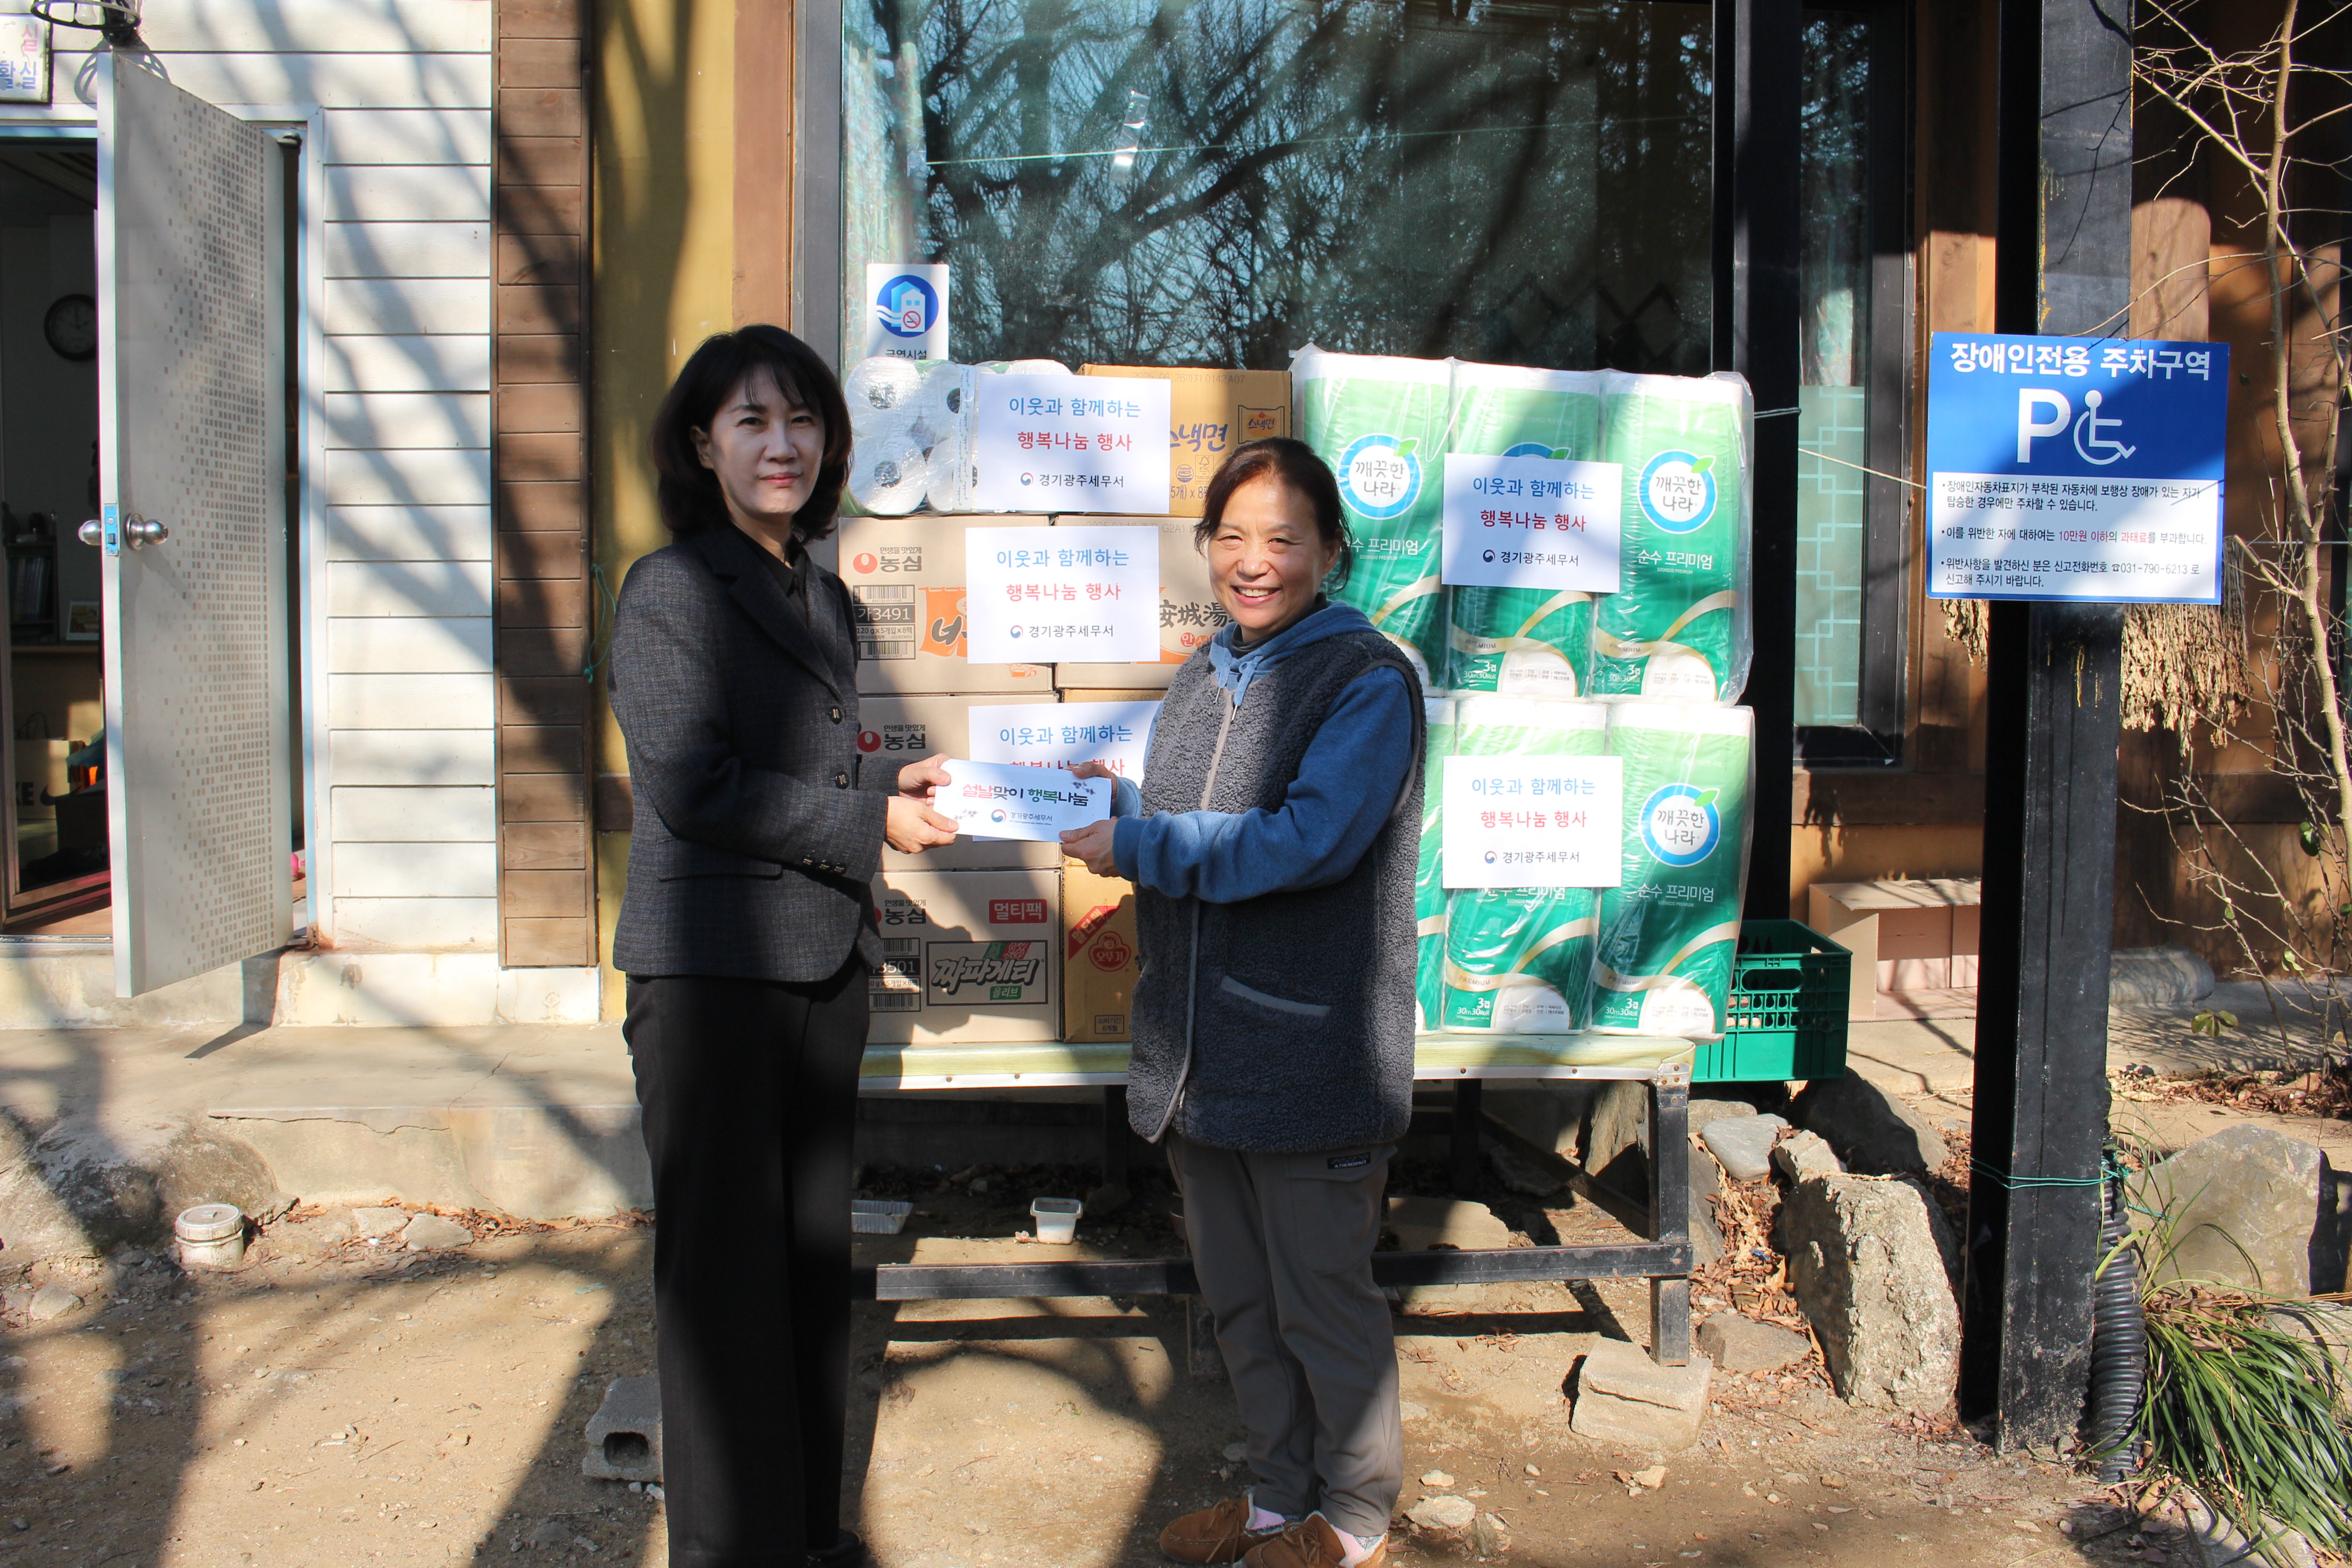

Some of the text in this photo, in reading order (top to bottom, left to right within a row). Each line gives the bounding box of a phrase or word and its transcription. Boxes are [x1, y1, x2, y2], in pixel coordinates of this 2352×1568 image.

[1950, 343, 2210, 381] 장애인전용 주차구역
[1009, 397, 1141, 418] 이웃과 함께하는
[1249, 418, 1275, 431] 스낵면
[2017, 388, 2071, 463] P
[1017, 431, 1132, 451] 행복나눔 행사
[1355, 460, 1405, 480] 깨끗한
[1039, 473, 1124, 488] 경기광주세무서
[1364, 480, 1396, 498] 나라
[1473, 477, 1595, 499] 이웃과 함께하는
[1656, 476, 1701, 495] 깨끗한
[1947, 480, 2200, 499] 장애인자동차표지가 부착된 자동차에 보행상 장애가 있는 자가
[1663, 496, 1693, 513] 나라
[1947, 496, 2097, 511] 탑승한 경우에만 주차할 수 있습니다.
[1480, 510, 1587, 532] 행복나눔 행사
[1946, 527, 2207, 544] 이를 위반한 자에 대하여는 10만원 이하의 과태료를 부과합니다.
[1367, 538, 1418, 555] 프리미엄
[879, 555, 922, 573] 농심
[996, 548, 1129, 568] 이웃과 함께하는
[1500, 552, 1579, 566] 경기광주세무서
[1637, 549, 1713, 570] 순수 프리미엄
[1946, 558, 1990, 570] 위반사항을
[1994, 559, 2029, 571] 발견하신
[2033, 560, 2050, 572] 분은
[2054, 561, 2107, 573] 신고전화번호
[2191, 564, 2200, 575] 로
[1946, 573, 2043, 587] 신고해 주시기 바랍니다.
[1006, 582, 1121, 602] 행복나눔 행사
[858, 608, 910, 621] 가3491
[1160, 599, 1234, 628] 安城湯
[931, 616, 967, 645] 너
[1029, 624, 1113, 639] 경기광주세무서
[1483, 661, 1496, 672] 3겹
[1627, 664, 1641, 676] 3겹
[884, 733, 926, 750] 농심
[1000, 725, 1133, 746] 이웃과 함께하는
[963, 784, 1089, 806] 설날맞이 행복나눔
[1471, 777, 1596, 796] 이웃과 함께하는
[1010, 812, 1052, 821] 경기광주세무서
[1480, 810, 1587, 828] 행복나눔 행사
[1657, 808, 1705, 829] 깨끗한
[1665, 830, 1696, 846] 나라
[1502, 851, 1580, 863] 경기광주세무서
[1515, 887, 1565, 900] 프리미엄
[1637, 883, 1714, 902] 순수 프리미엄
[885, 908, 926, 925] 농심
[995, 902, 1042, 920] 멀티팩
[1072, 908, 1106, 944] 멀티팩
[1097, 951, 1123, 962] 오뚜기
[872, 961, 915, 975] 3501
[931, 957, 1039, 995] 짜파게티
[1459, 975, 1491, 986] PREMIUM
[993, 987, 1019, 998] 올리브
[1477, 997, 1490, 1009] 3겹
[1625, 998, 1639, 1009] 3겹
